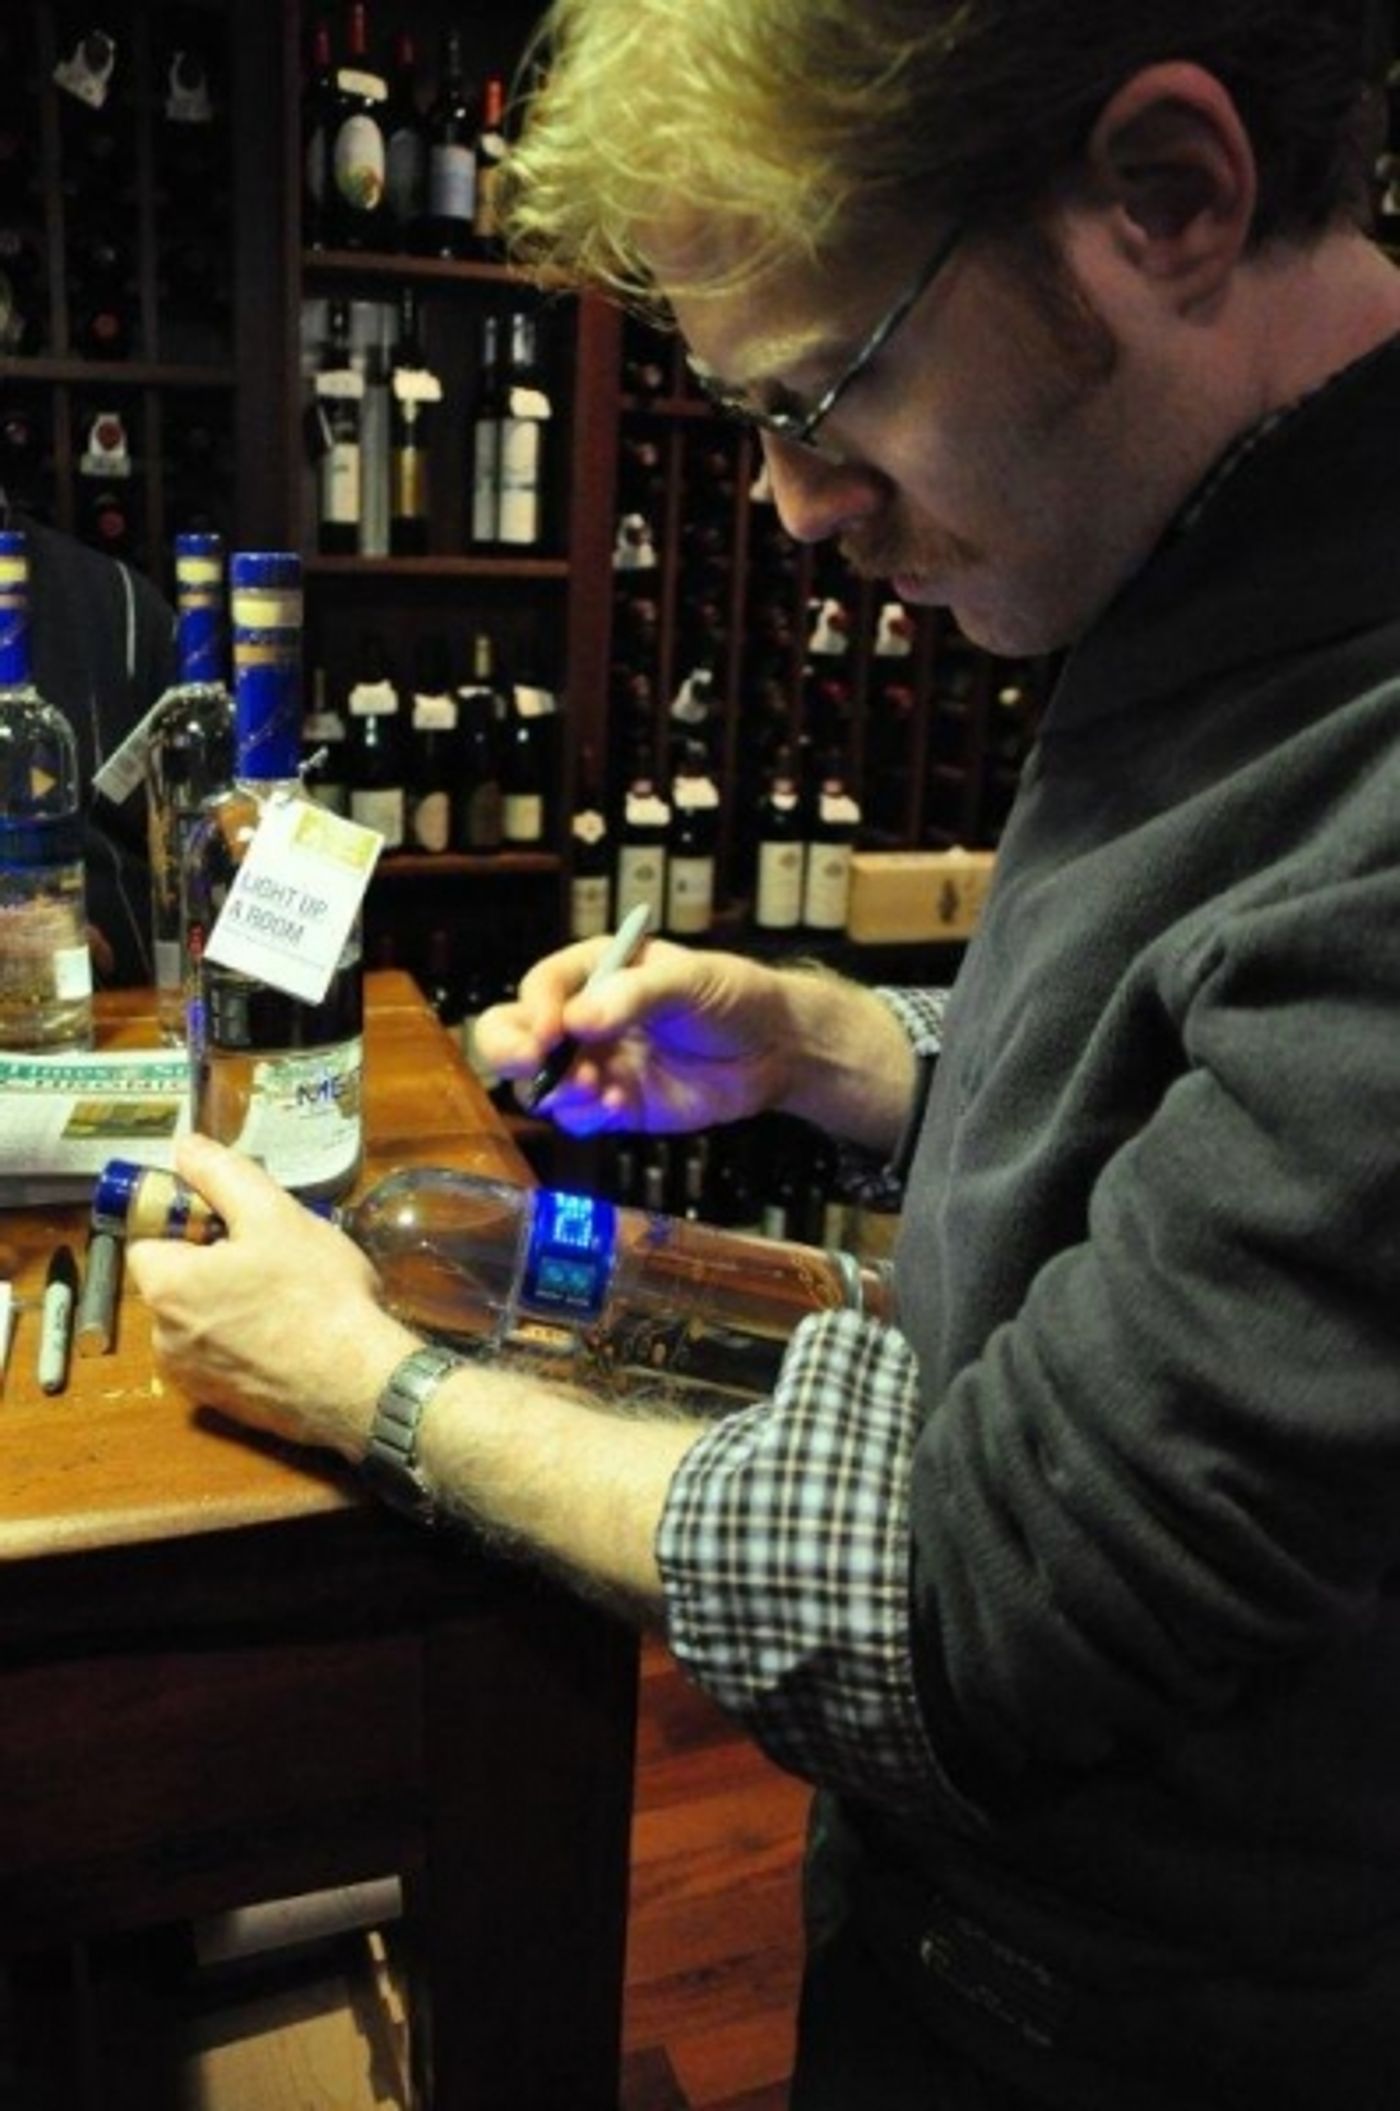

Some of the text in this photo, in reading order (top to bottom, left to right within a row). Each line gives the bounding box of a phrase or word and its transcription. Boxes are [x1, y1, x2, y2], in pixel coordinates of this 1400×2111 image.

[241, 869, 328, 921] LIGHT UP
[246, 903, 304, 945] ROOM
